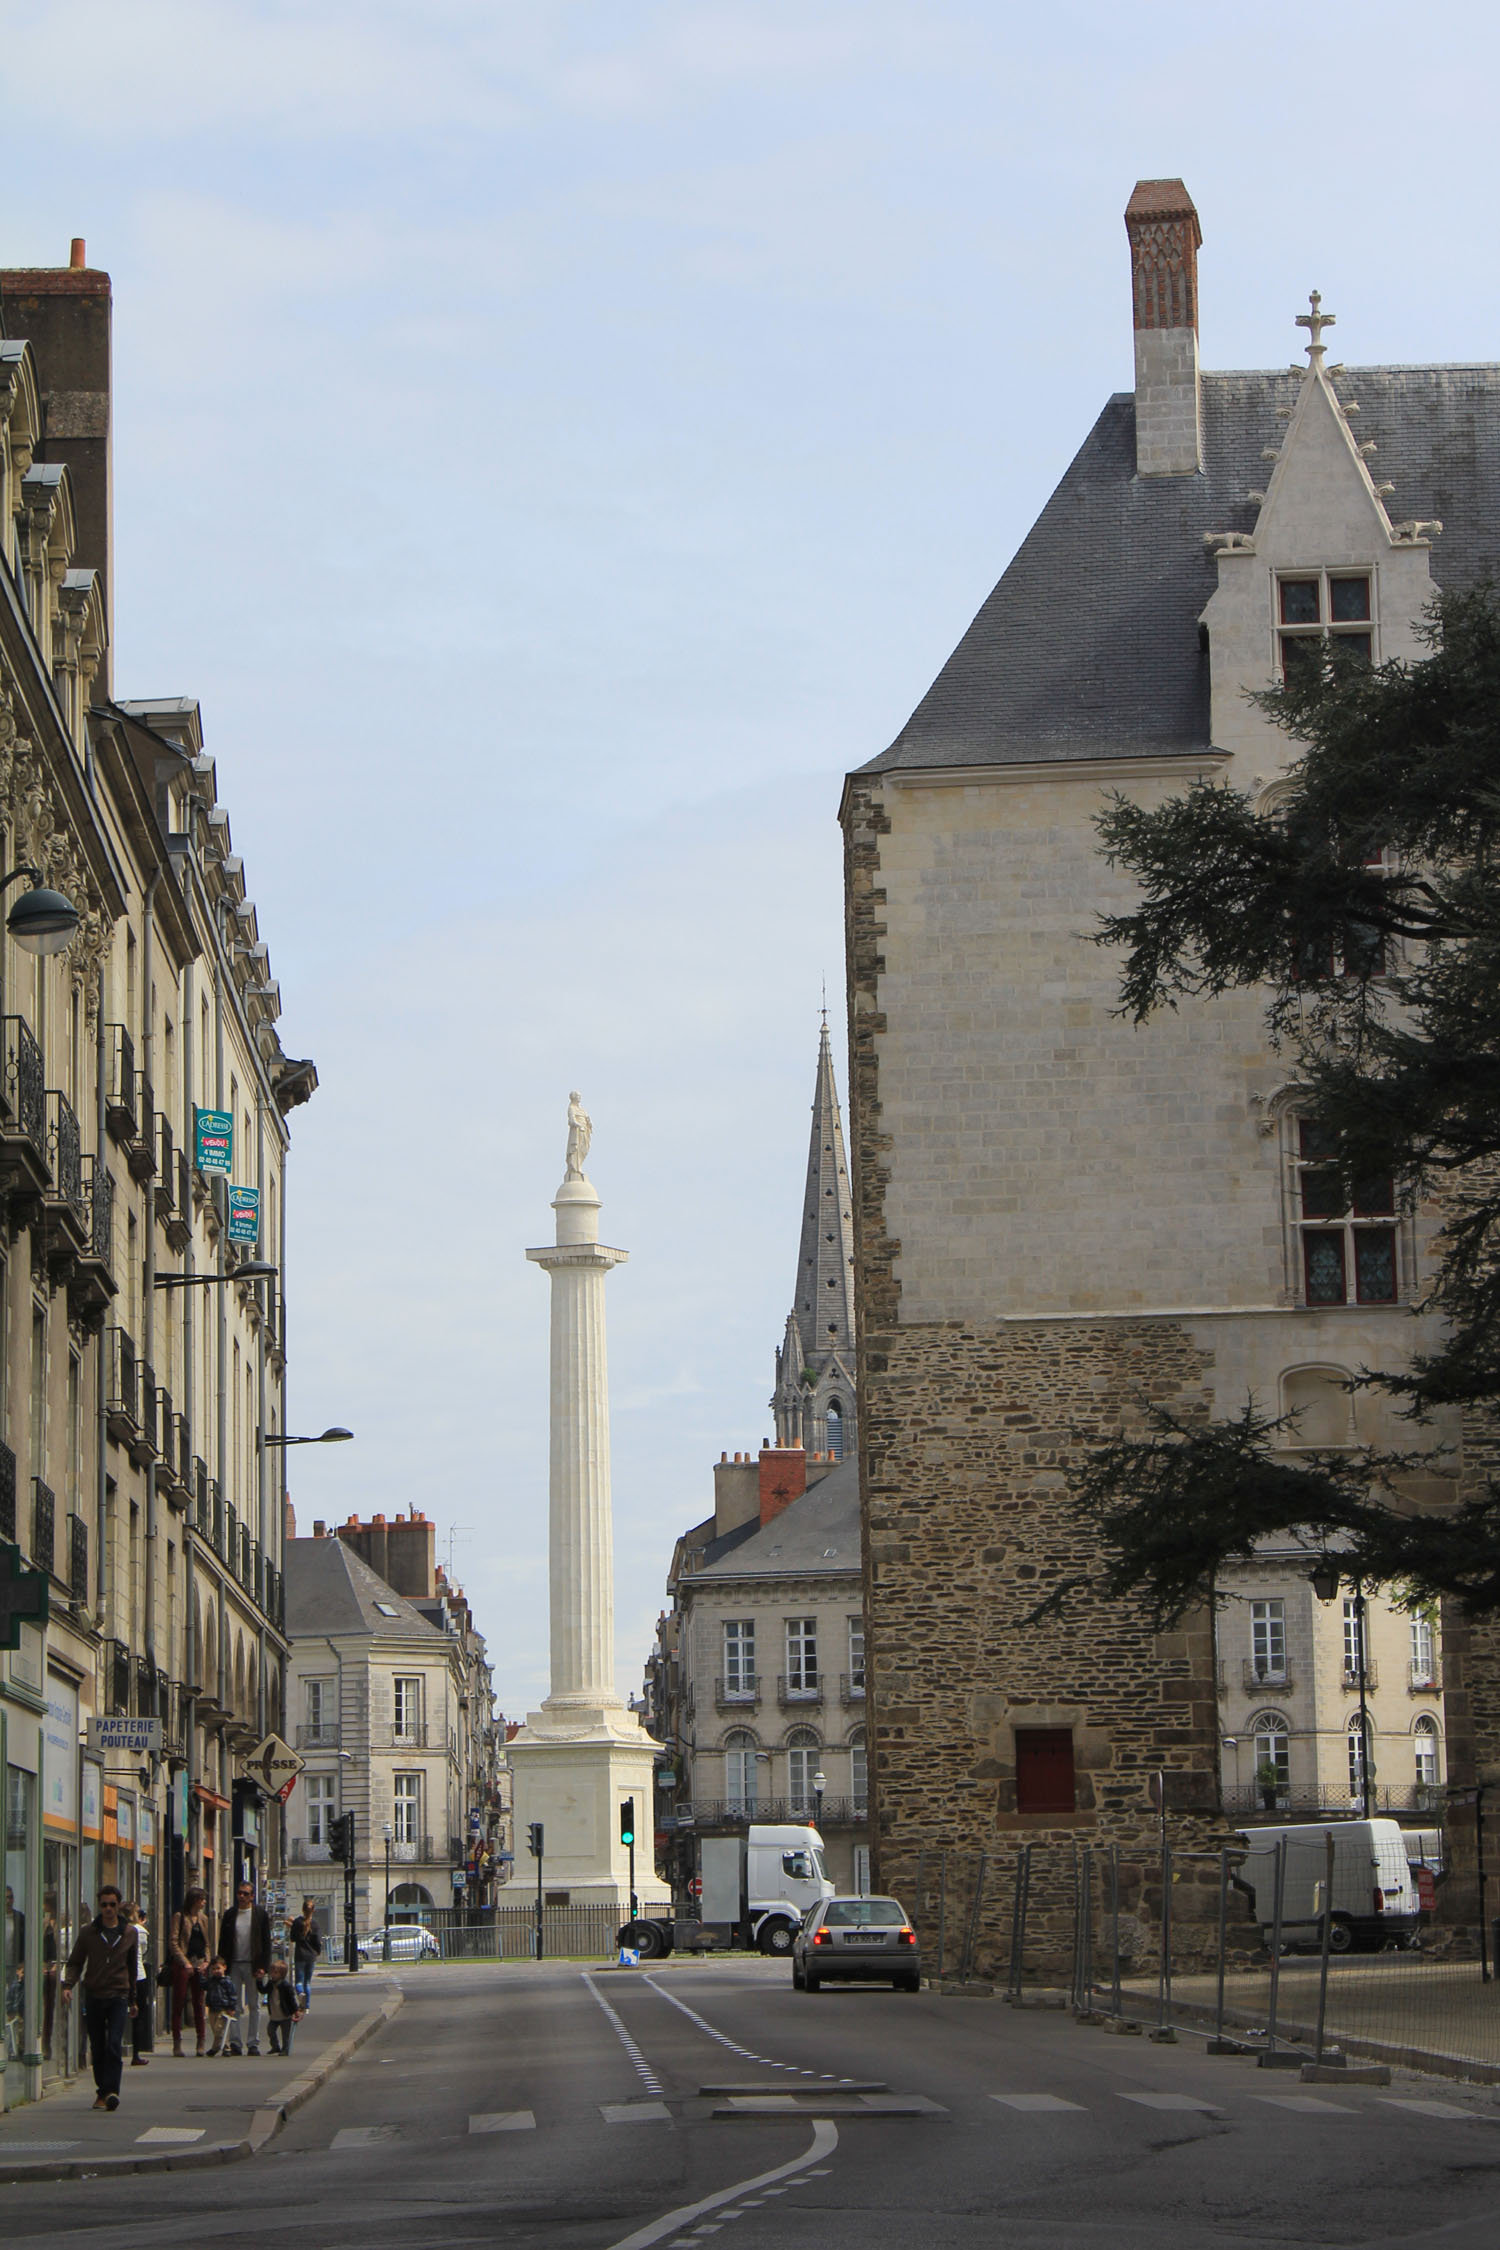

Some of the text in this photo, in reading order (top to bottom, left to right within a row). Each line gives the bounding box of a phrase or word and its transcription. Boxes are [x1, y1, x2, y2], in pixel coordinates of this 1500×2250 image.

[205, 1139, 225, 1147] VENDU
[96, 1720, 154, 1733] PAPETERIE
[101, 1735, 148, 1747] POUTEAU
[246, 1760, 297, 1770] PRSSE
